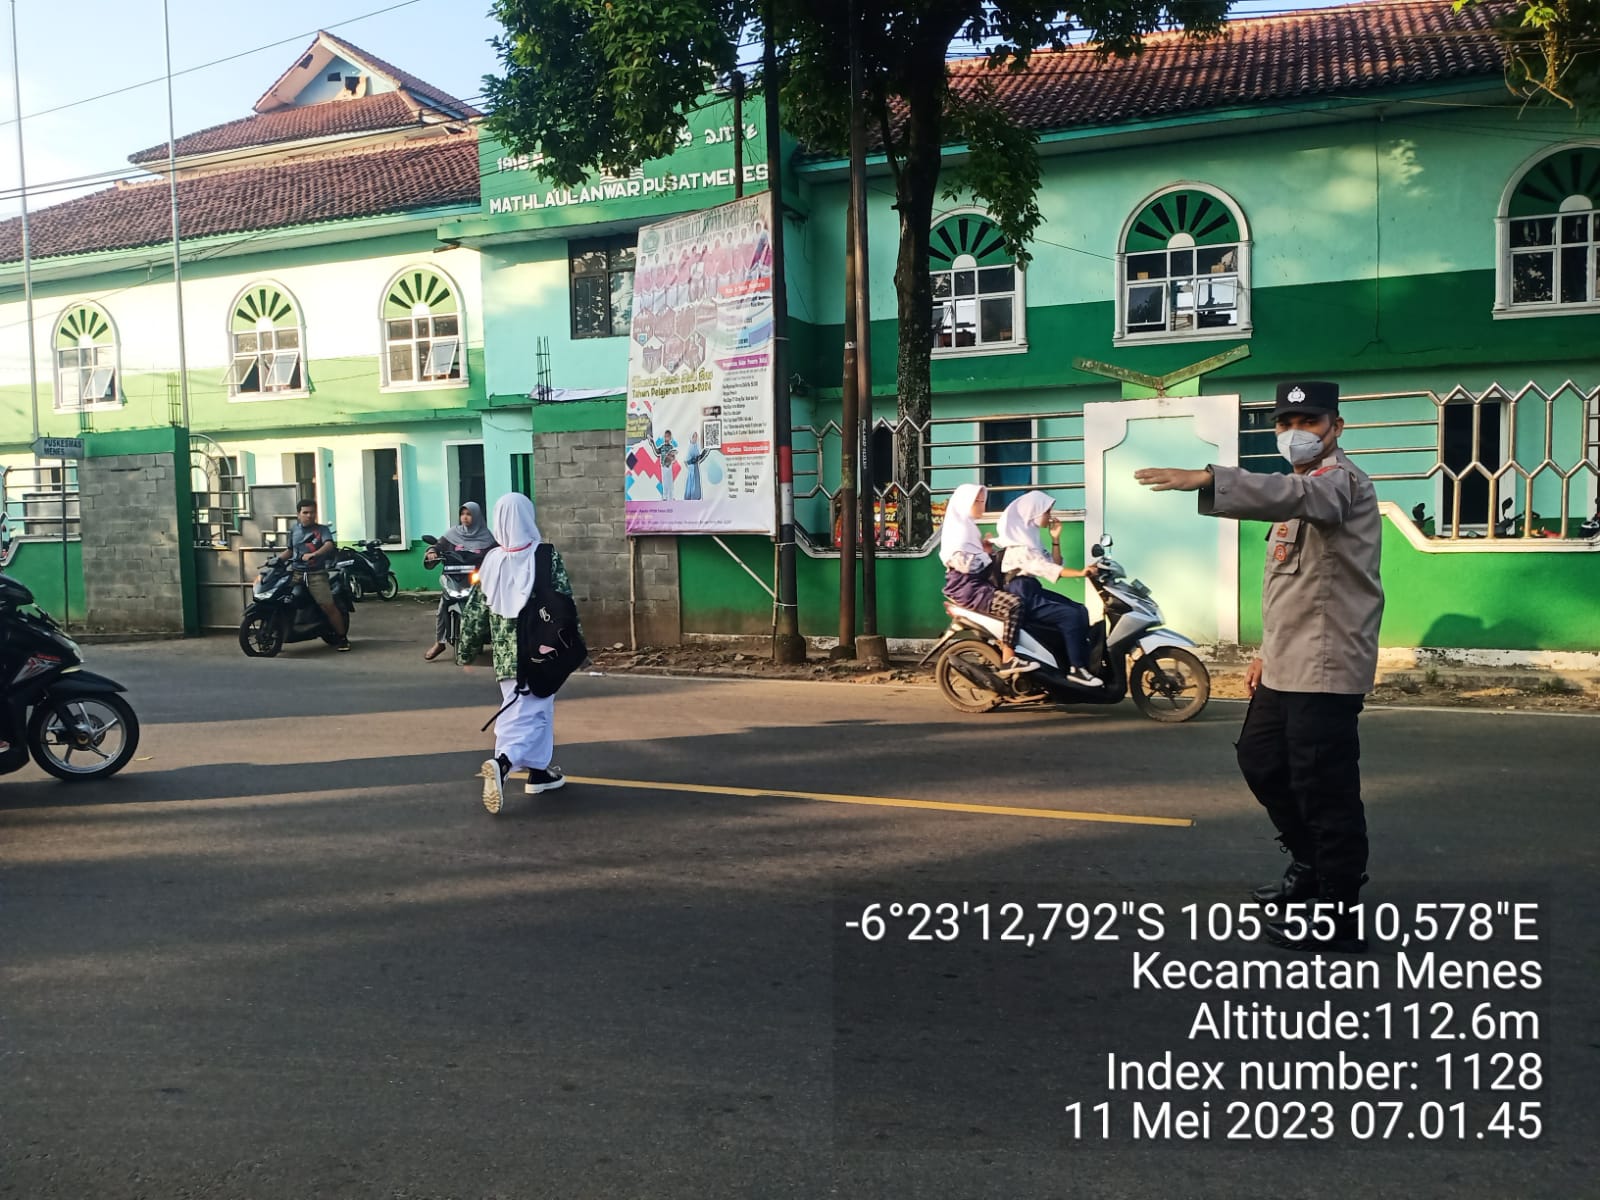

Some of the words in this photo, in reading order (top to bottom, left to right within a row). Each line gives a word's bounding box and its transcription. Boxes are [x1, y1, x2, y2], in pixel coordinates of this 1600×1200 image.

[643, 172, 701, 195] PUSAT
[44, 439, 82, 448] PUSKESMAS
[44, 447, 65, 456] MENES
